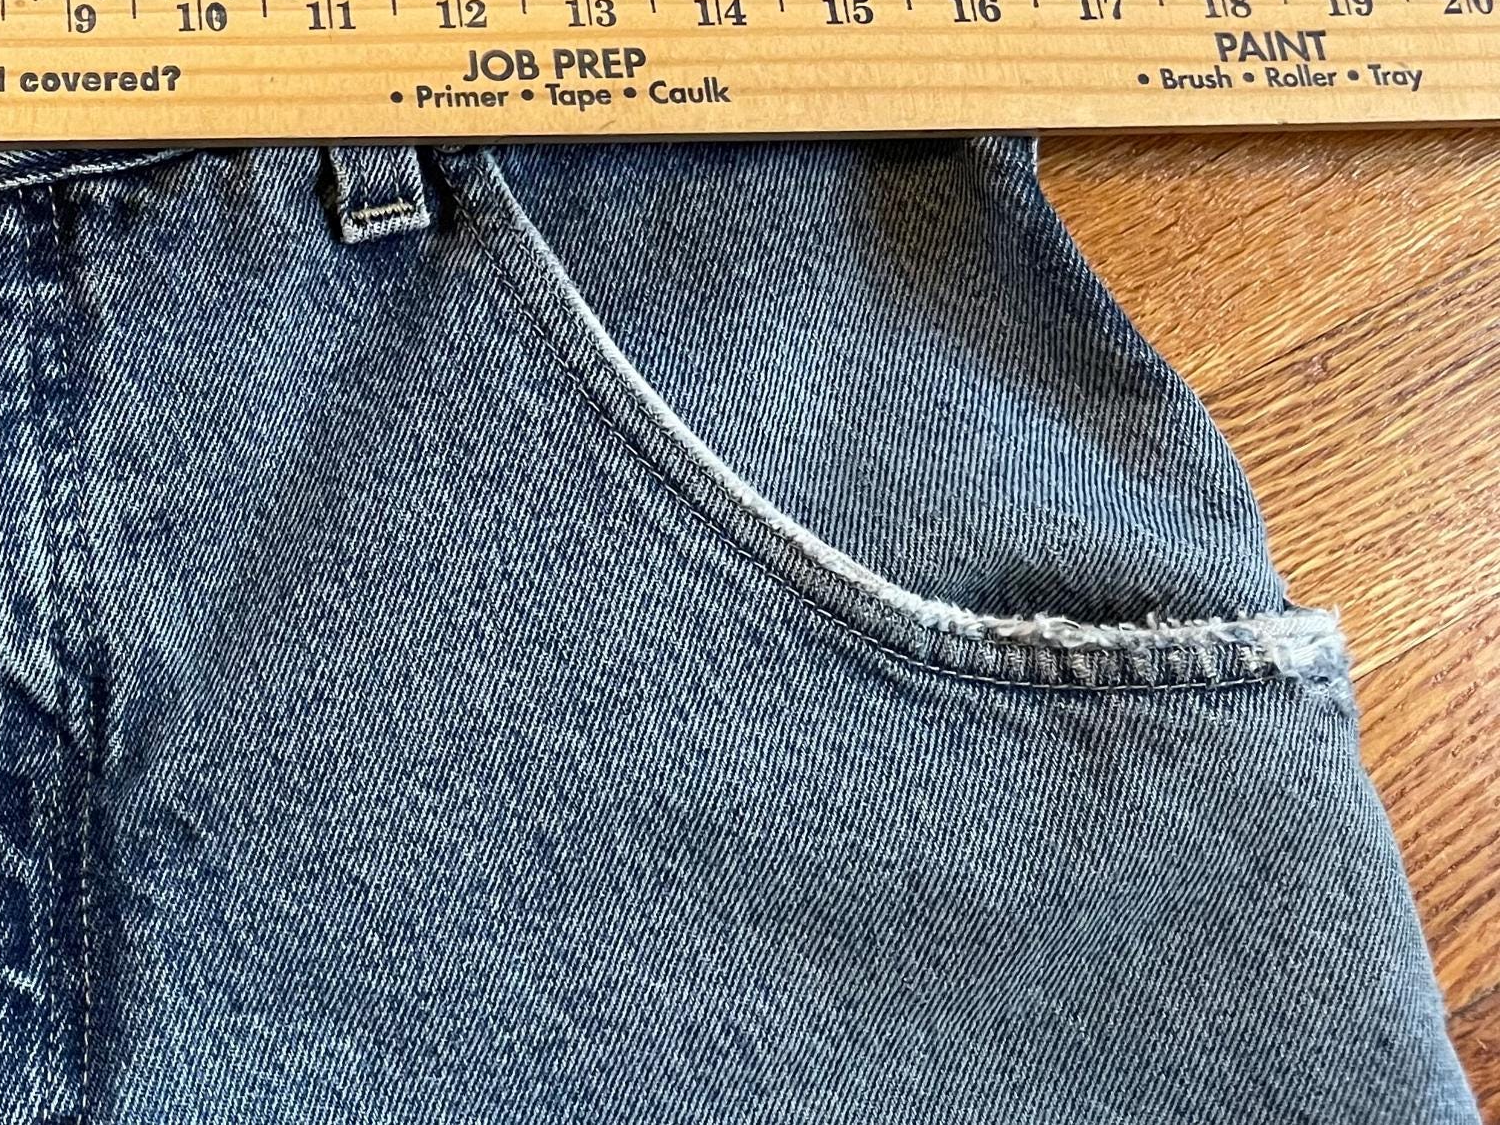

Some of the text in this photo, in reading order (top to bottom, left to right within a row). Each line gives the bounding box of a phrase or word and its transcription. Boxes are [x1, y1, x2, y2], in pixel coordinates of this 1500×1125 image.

[74, 4, 97, 34] 9
[176, 2, 228, 32] 10
[306, 1, 357, 31] 11
[436, 0, 487, 29] 12
[566, 0, 617, 28] 13
[1214, 29, 1328, 63] PAINT
[19, 65, 181, 92] covered?
[462, 47, 647, 82] JOB PREP
[1159, 63, 1423, 92] Brush Roller Tray
[416, 76, 731, 112] Primer Tape Caulk
